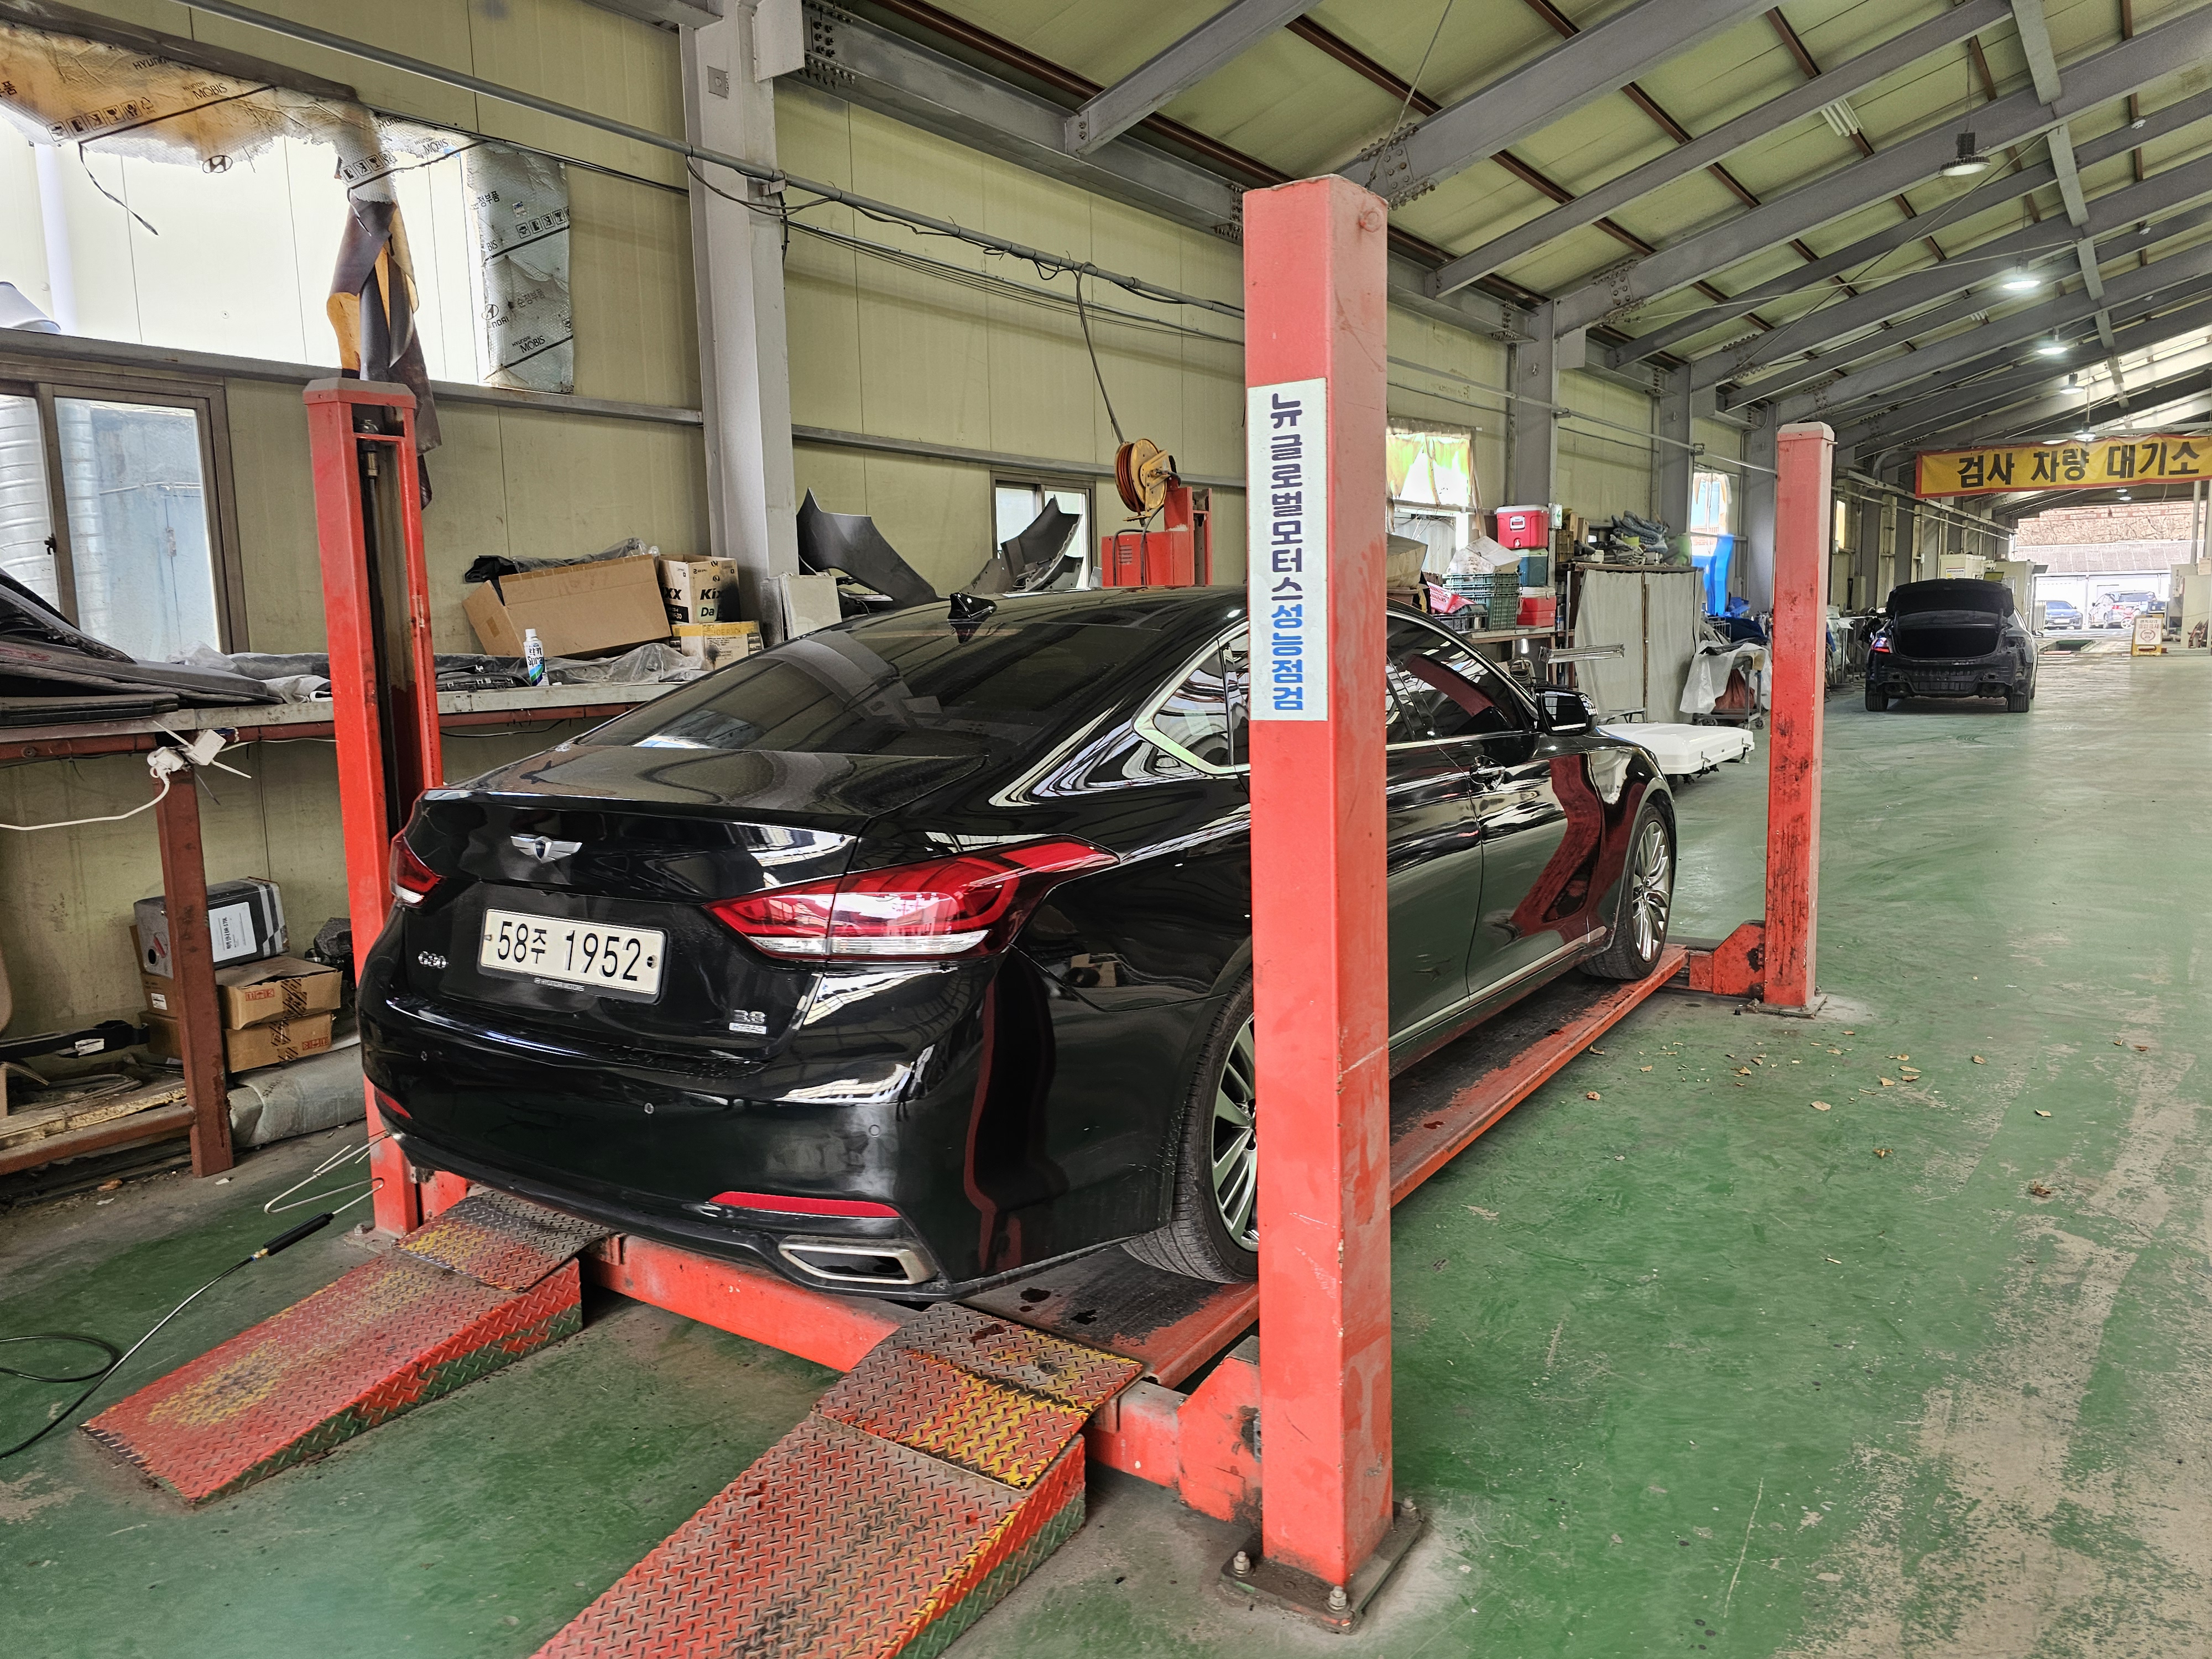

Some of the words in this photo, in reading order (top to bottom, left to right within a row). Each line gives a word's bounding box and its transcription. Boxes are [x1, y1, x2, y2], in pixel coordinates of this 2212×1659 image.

[192, 83, 227, 100] MOBIS
[422, 138, 449, 154] MOBIS
[520, 336, 545, 353] MOBIS
[1957, 452, 2015, 488] 검사
[2031, 448, 2089, 483] 차량
[2107, 441, 2200, 479] 대기소
[497, 921, 547, 964] 58주
[566, 930, 641, 982] 1952
